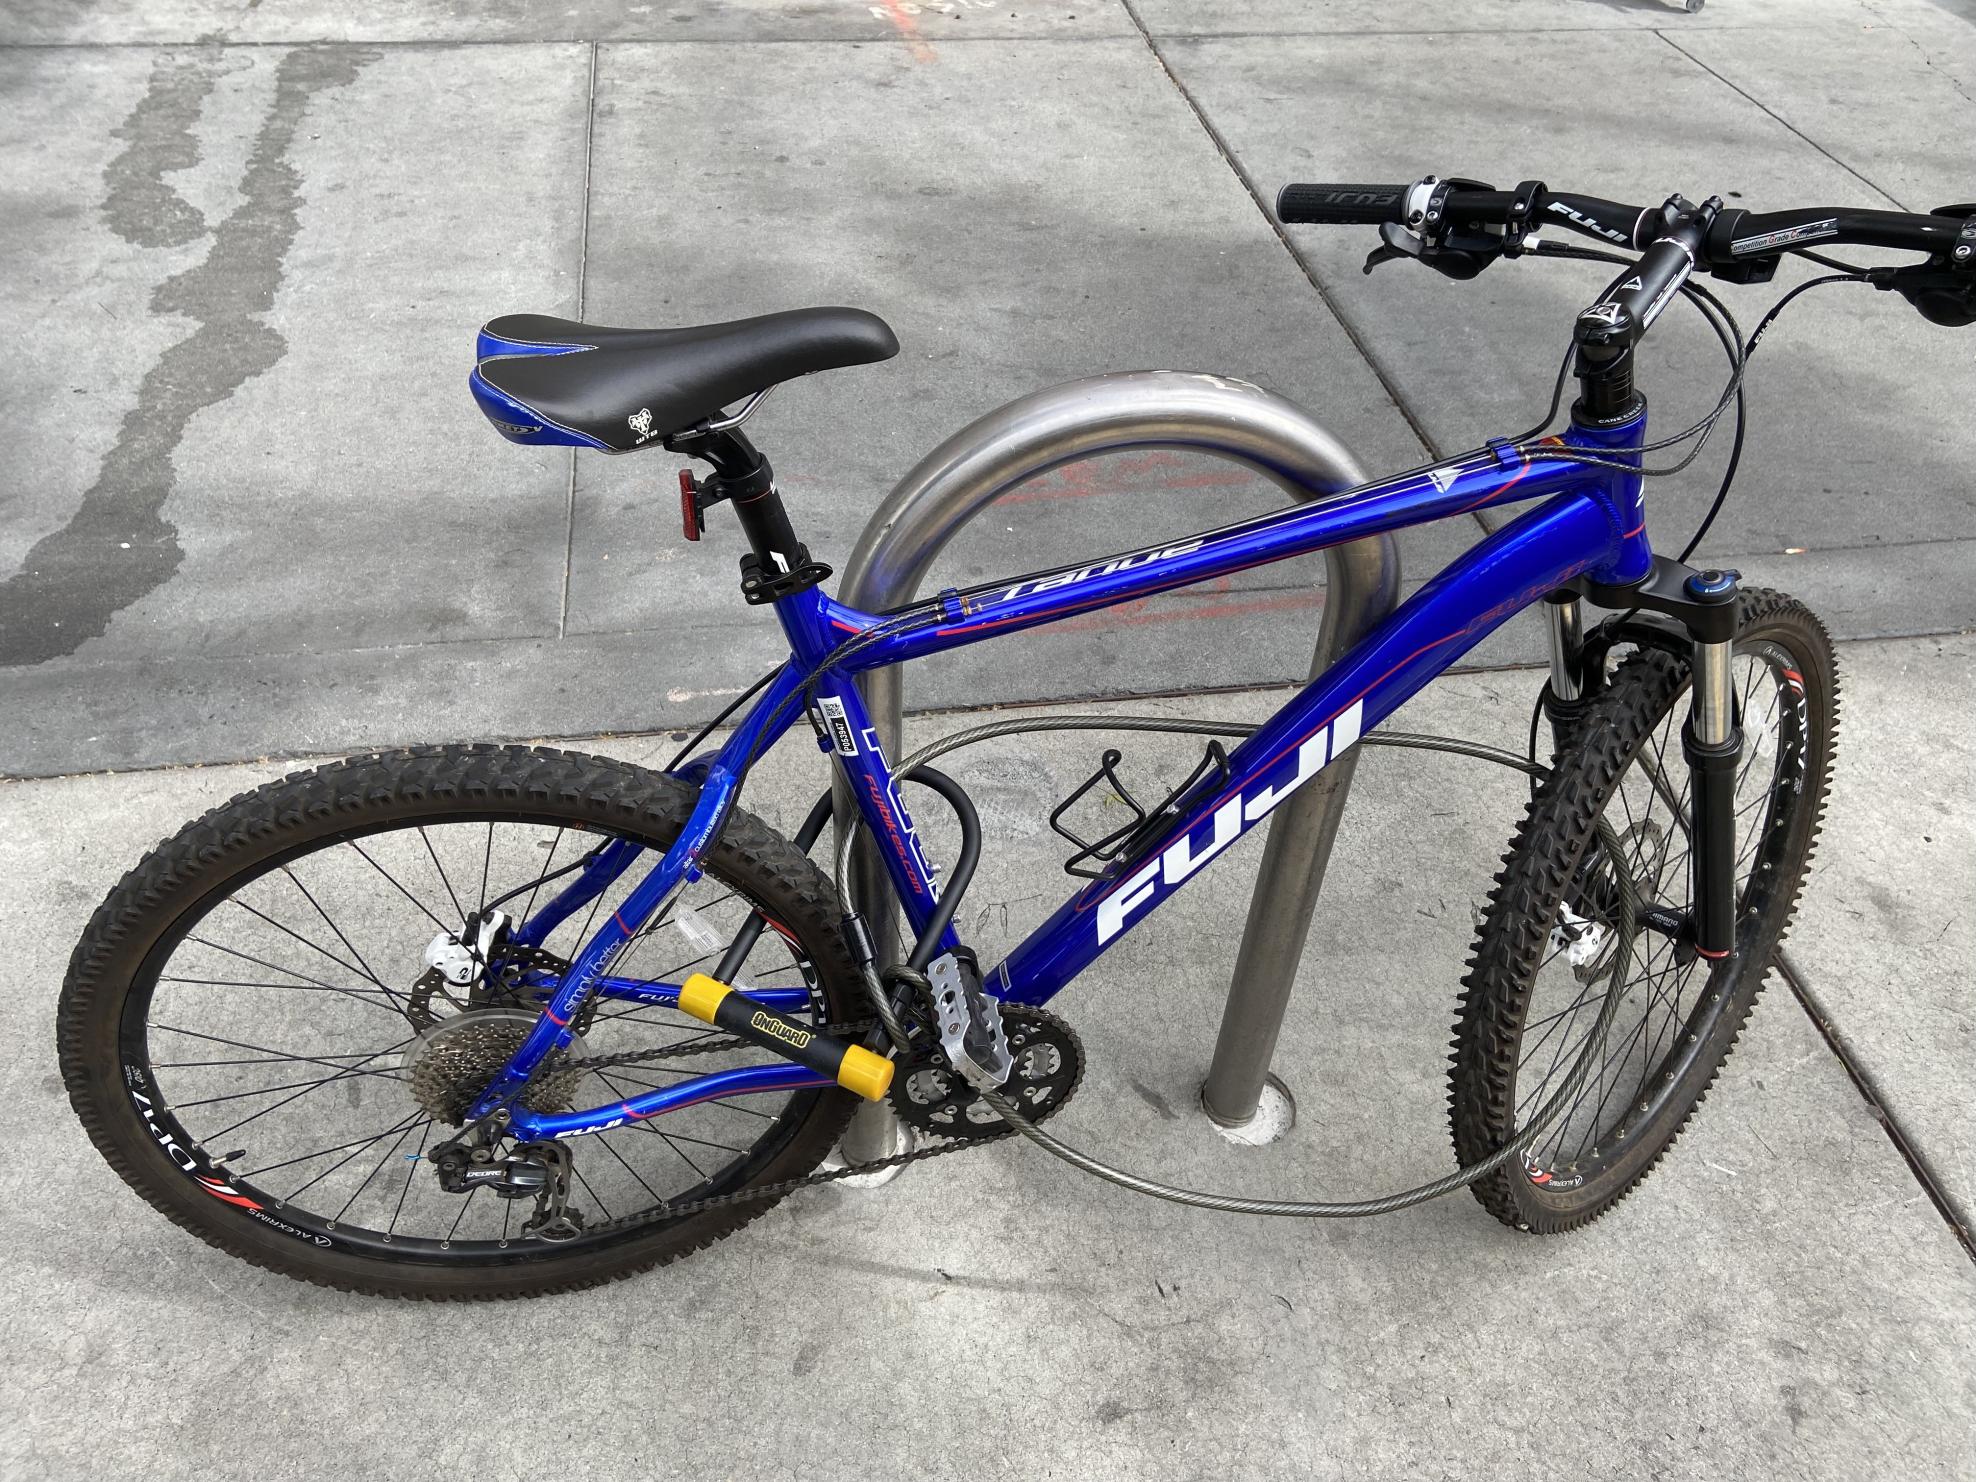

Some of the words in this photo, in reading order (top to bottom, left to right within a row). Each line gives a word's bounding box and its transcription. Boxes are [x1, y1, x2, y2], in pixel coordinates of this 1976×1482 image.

[1324, 191, 1399, 205] FUJI
[1547, 201, 1628, 243] FUJI
[1768, 234, 1790, 245] Grade
[1754, 318, 1773, 344] FUJI
[1598, 416, 1622, 424] CANE
[1623, 402, 1644, 419] CREEK
[635, 429, 658, 445] WTB
[835, 722, 852, 752] P053947
[1097, 698, 1363, 945] FUJI
[554, 1117, 623, 1138] FUJI
[247, 1207, 312, 1239] ALEXRIMS
